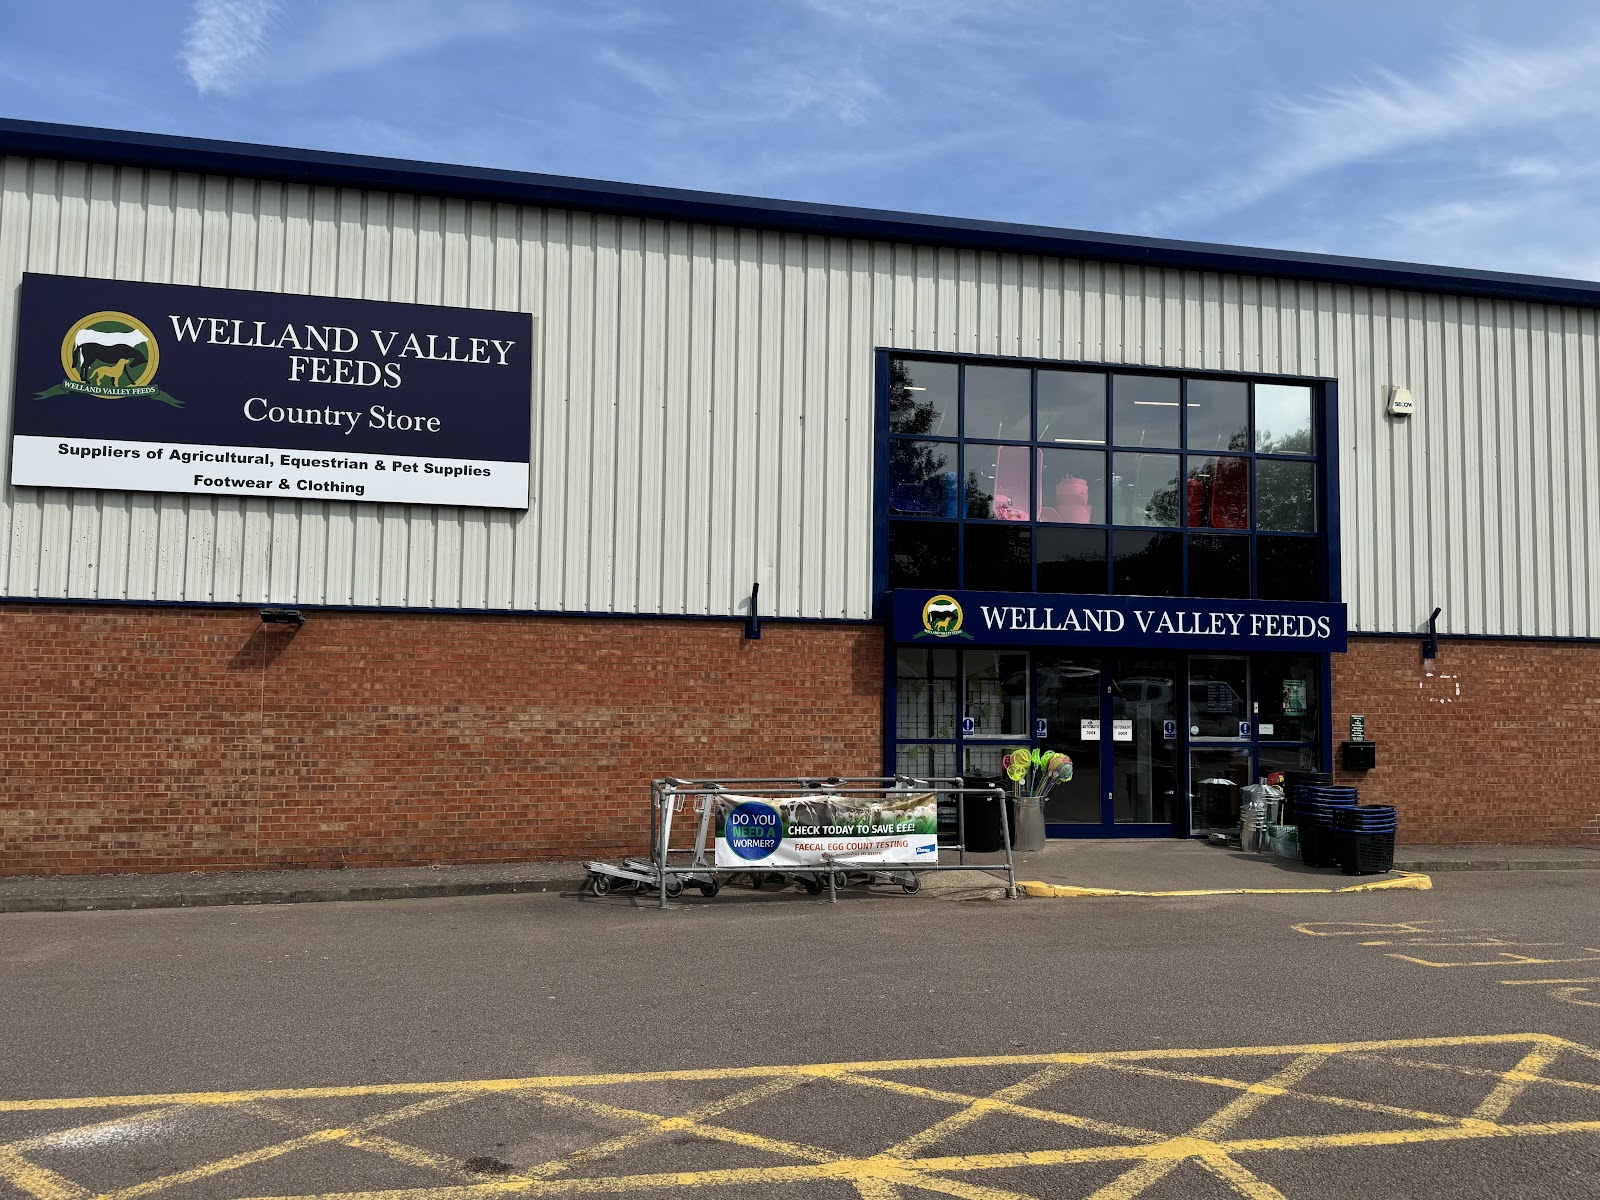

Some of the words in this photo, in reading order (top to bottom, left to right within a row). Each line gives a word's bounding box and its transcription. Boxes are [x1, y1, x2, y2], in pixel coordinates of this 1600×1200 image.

[168, 314, 359, 353] WELLAND
[371, 330, 516, 366] VALLEY
[288, 355, 402, 389] FEEDS
[64, 380, 101, 394] WELLAND
[103, 387, 131, 395] VALLEY
[132, 386, 156, 395] FEEDS
[243, 397, 362, 435] Country
[368, 404, 441, 432] Store
[57, 443, 141, 459] Suppliers
[146, 448, 164, 459] of
[168, 449, 274, 467] Agricultural,
[280, 454, 368, 470] Equestrian
[374, 459, 386, 471] &
[392, 460, 419, 473] Pet
[423, 462, 491, 478] Supplies
[194, 474, 273, 489] Footwear
[278, 478, 291, 490] &
[296, 479, 365, 496] Clothing
[979, 605, 1125, 632] WELLAND
[1133, 610, 1245, 636] VALLEY
[1250, 614, 1331, 639] FEEDS
[732, 814, 749, 825] DO
[752, 814, 776, 826] YOU
[787, 825, 821, 836] CHECK
[822, 825, 855, 836] TODAY
[857, 824, 870, 835] TO
[871, 823, 895, 834] SAVE
[896, 822, 915, 833] £££!
[732, 826, 765, 838] NEED
[766, 827, 776, 838] A
[732, 839, 776, 848] WORMER?
[794, 842, 826, 852] FAECAL
[827, 842, 844, 851] EGG
[846, 841, 875, 851] COUNT
[876, 839, 909, 849] TESTING
